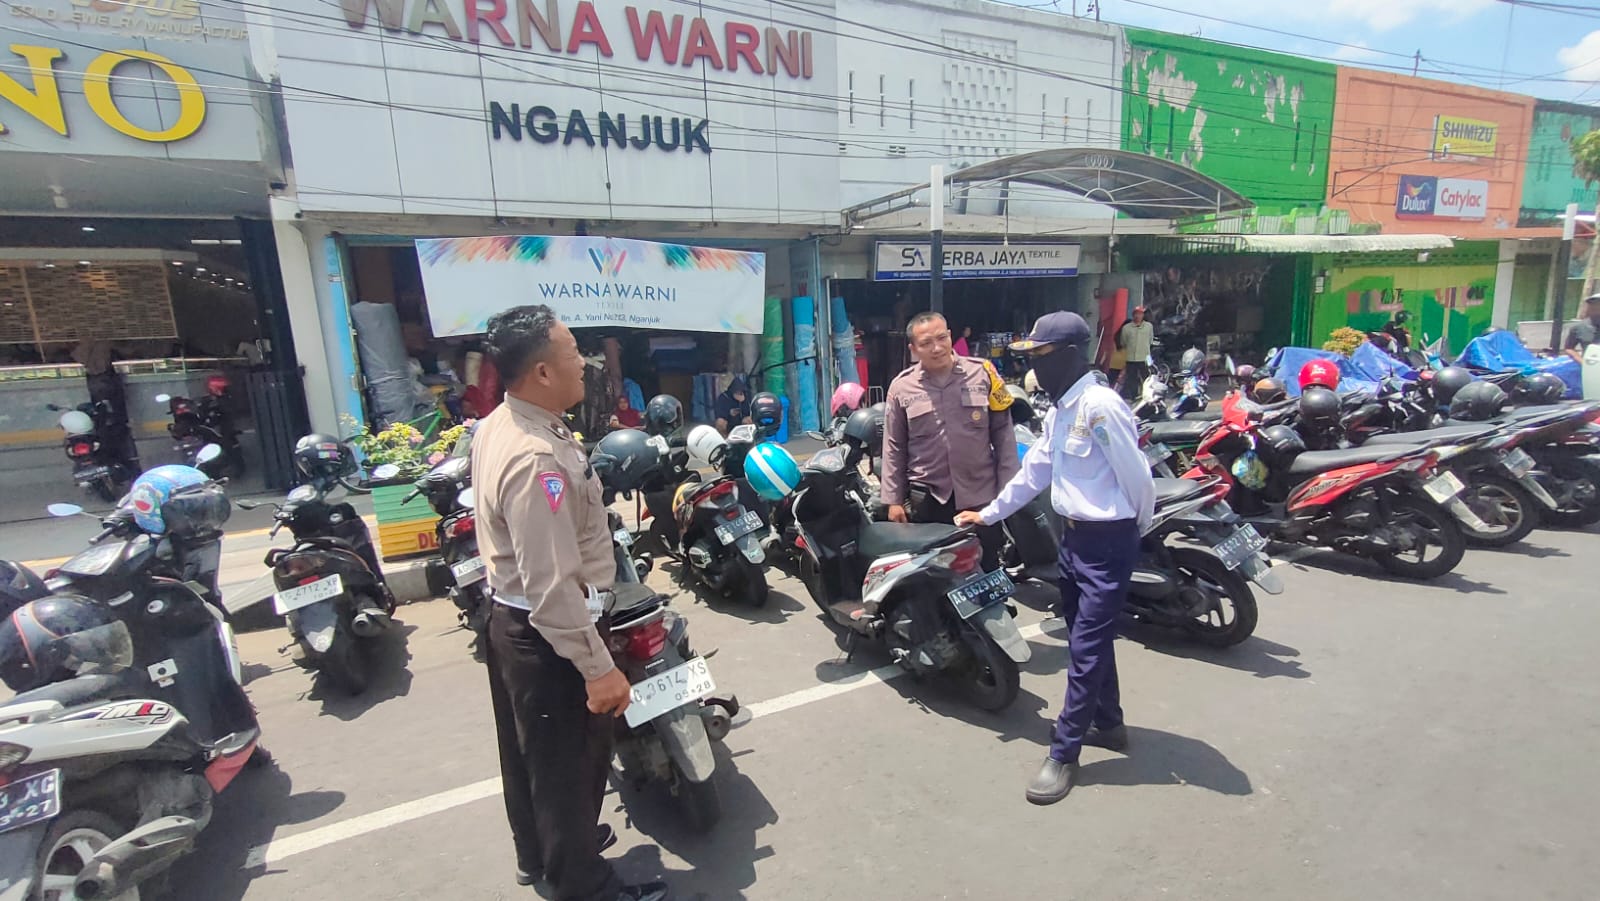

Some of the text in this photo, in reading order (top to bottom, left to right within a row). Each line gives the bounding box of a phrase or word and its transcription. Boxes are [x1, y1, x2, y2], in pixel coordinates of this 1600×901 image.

[337, 0, 813, 79] WARNA WARNI
[490, 101, 711, 153] NGANJUK
[1442, 121, 1493, 143] SHIMIZU
[1402, 187, 1482, 212] Dulux Catylac
[942, 250, 985, 266] ERBA
[1028, 250, 1060, 259] TEXTILE
[585, 313, 602, 321] Yani
[629, 314, 661, 324] Nganjuk
[952, 591, 967, 605] AG
[24, 775, 55, 801] XG
